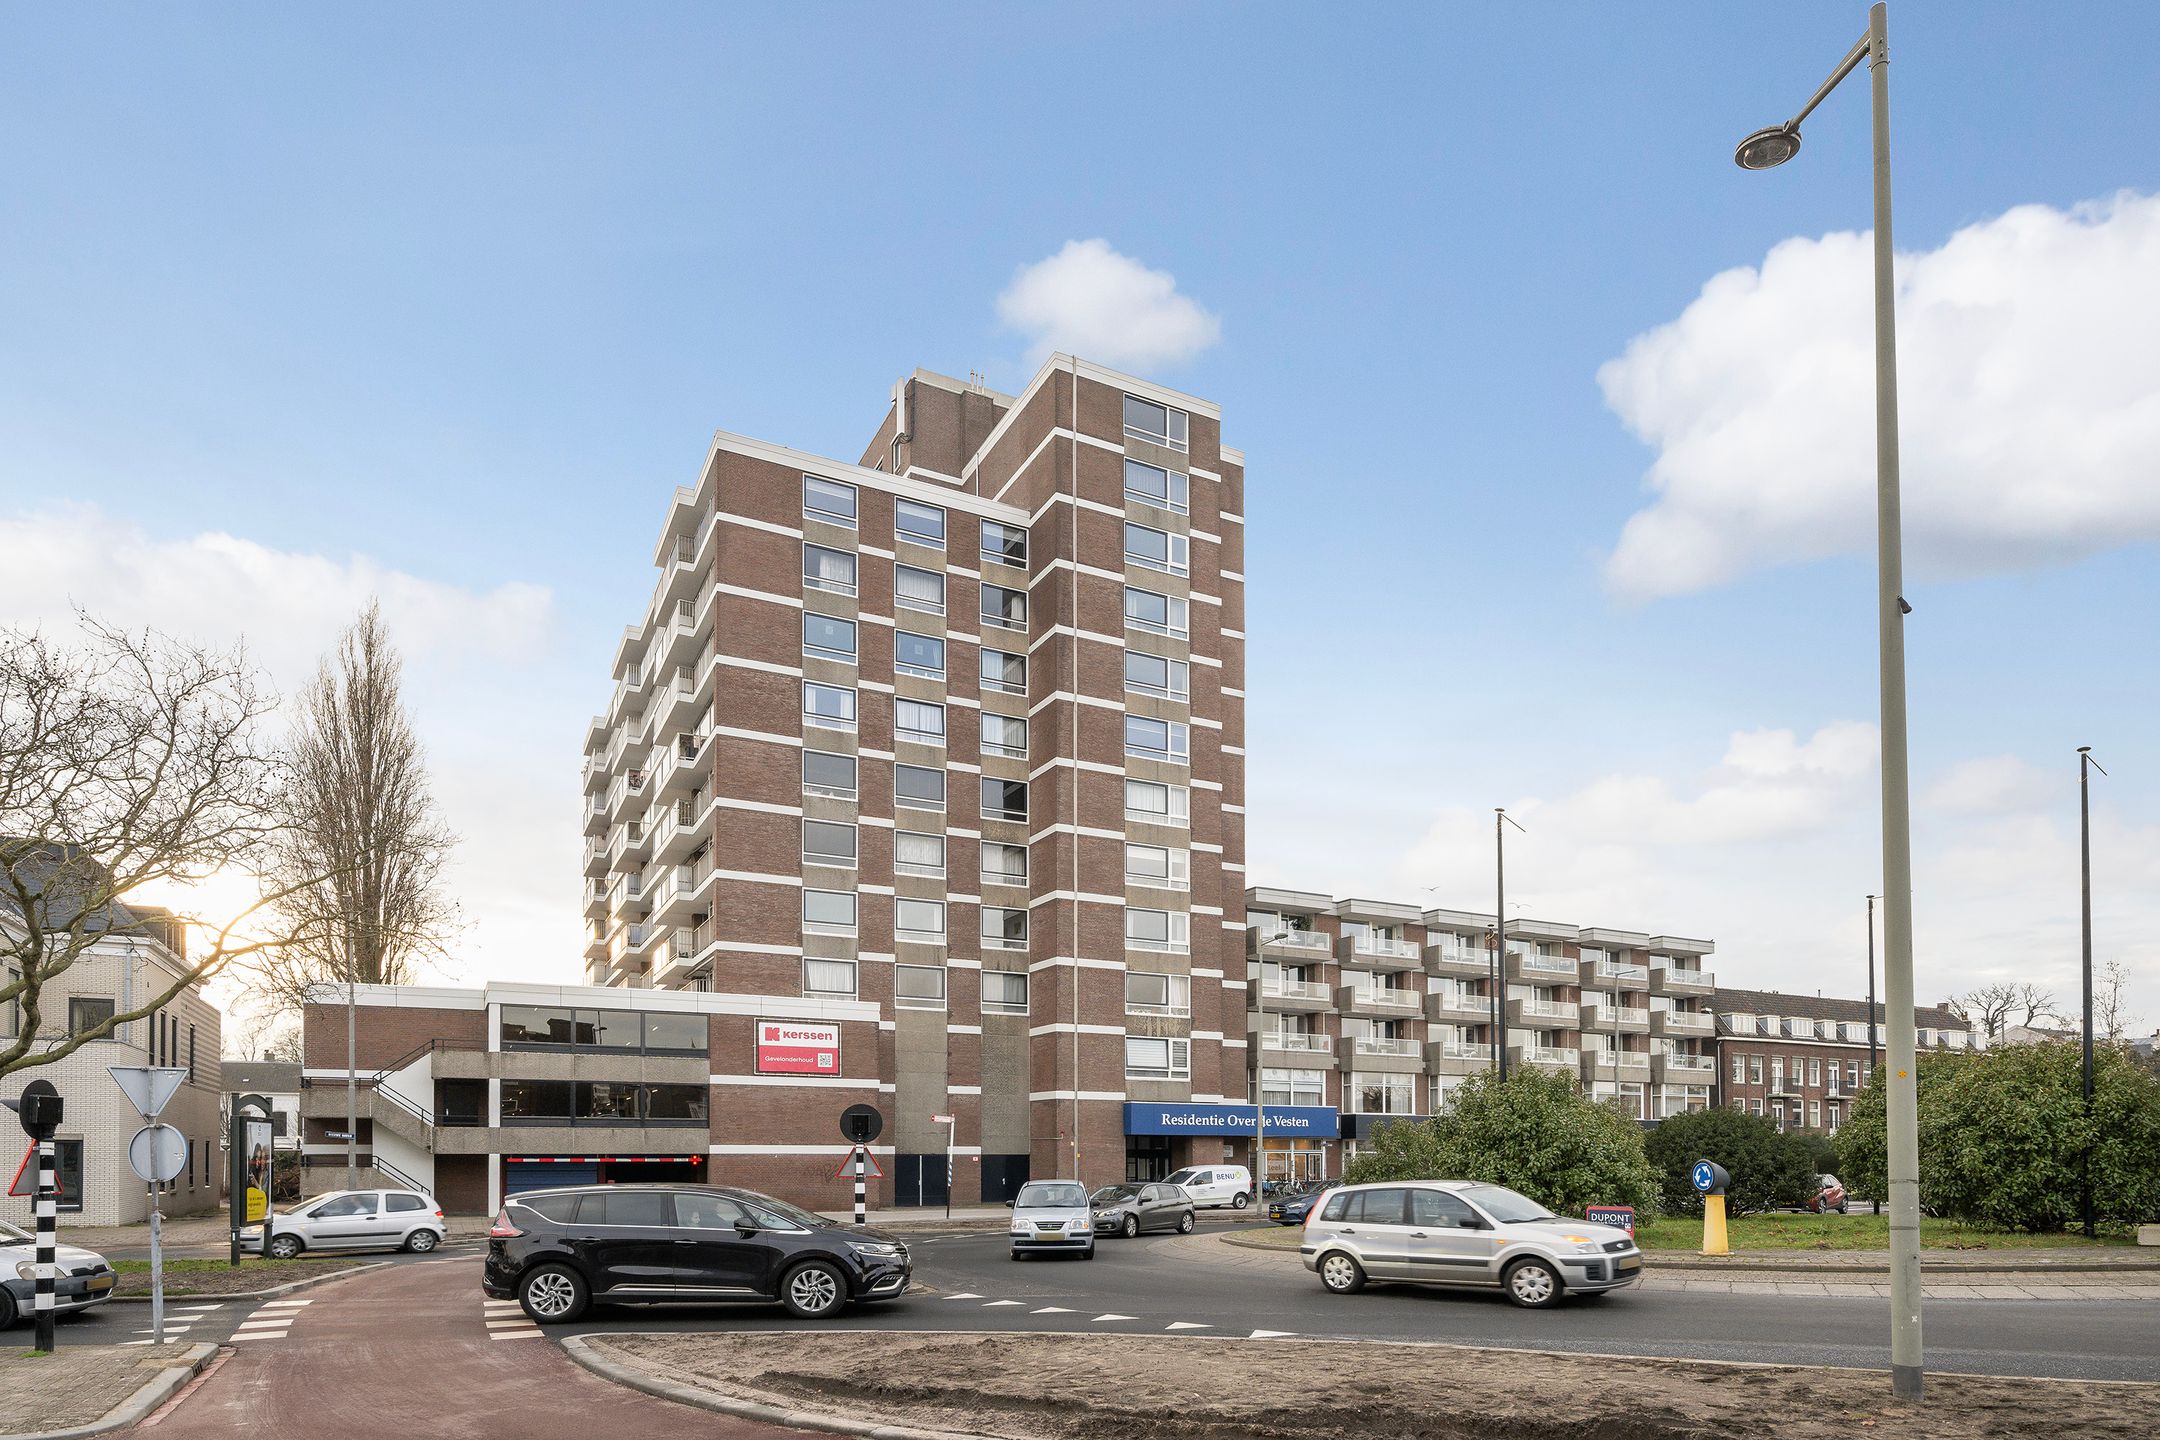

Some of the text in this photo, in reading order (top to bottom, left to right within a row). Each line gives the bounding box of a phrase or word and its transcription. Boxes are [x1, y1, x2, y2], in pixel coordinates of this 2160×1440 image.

[783, 1031, 833, 1041] kerssen
[764, 1055, 814, 1063] Gevelonderhoud
[1161, 1113, 1225, 1126] Residentie
[1227, 1114, 1256, 1127] Over
[1273, 1115, 1309, 1127] Vesten
[1216, 1173, 1235, 1181] BENU
[1591, 1213, 1630, 1222] DUPONT
